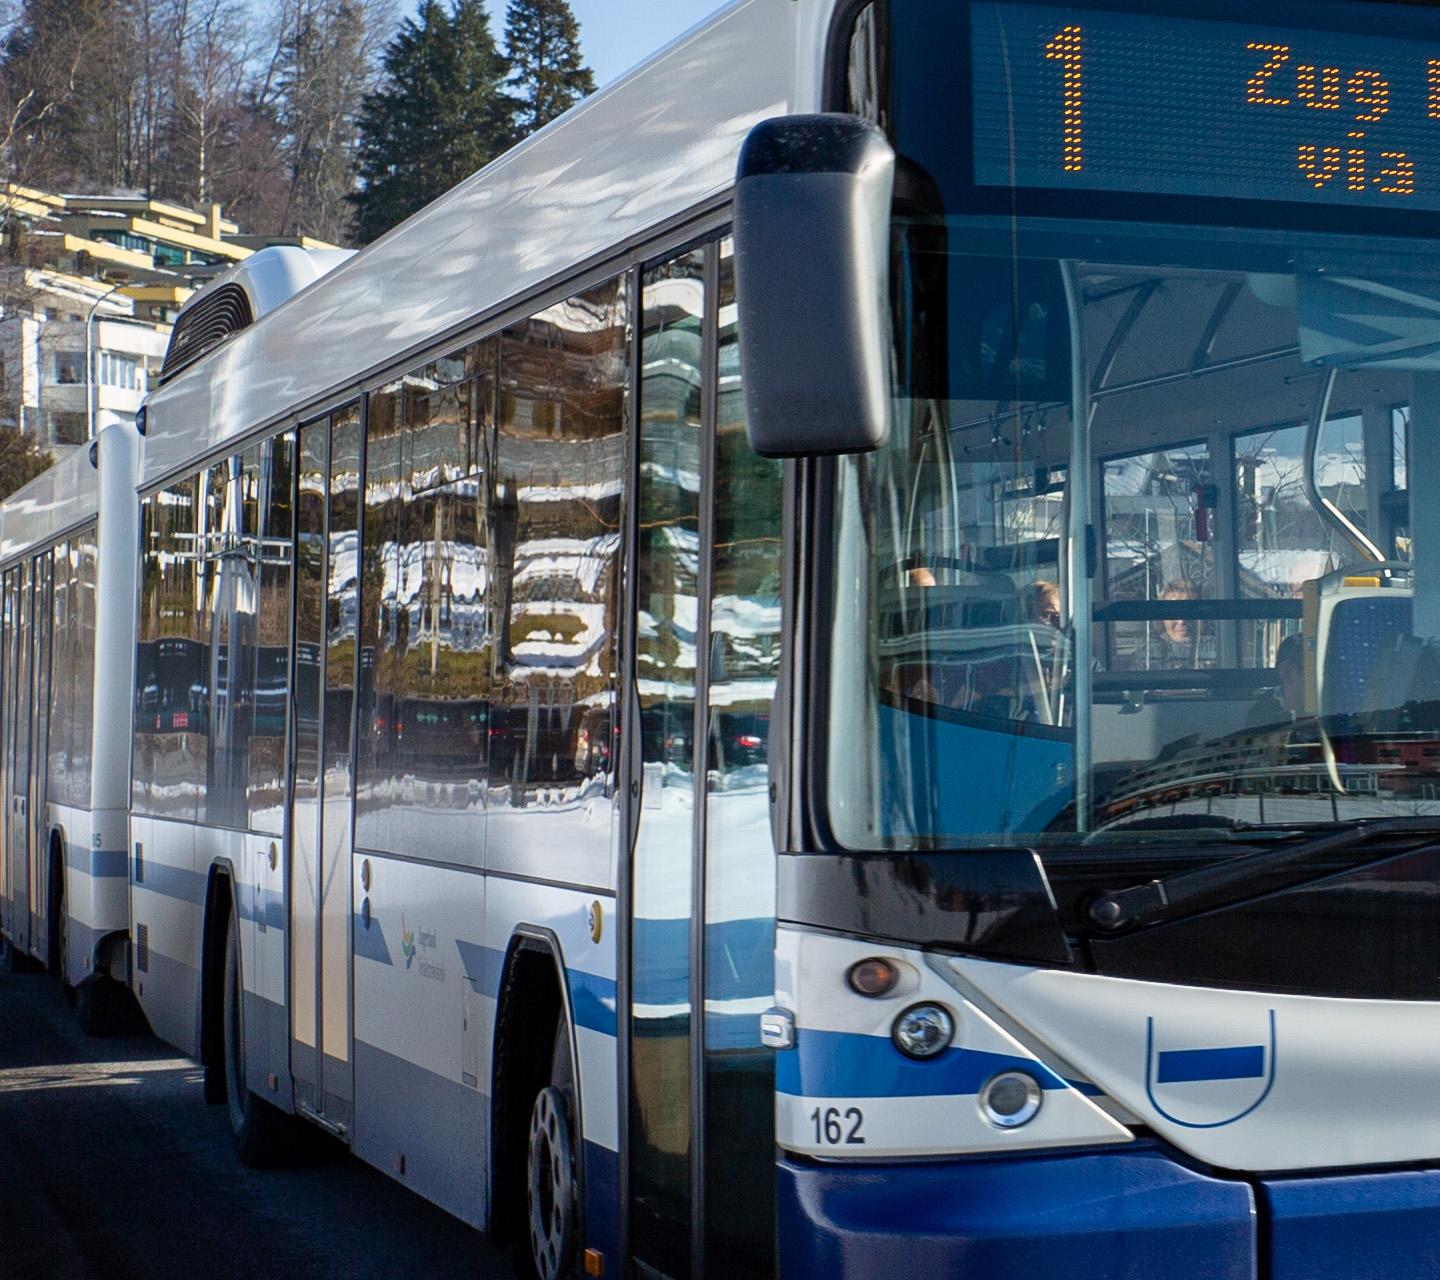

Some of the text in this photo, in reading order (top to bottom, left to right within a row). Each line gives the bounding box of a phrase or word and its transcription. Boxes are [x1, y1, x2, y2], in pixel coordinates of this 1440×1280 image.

[1045, 25, 1082, 172] 1
[1246, 43, 1389, 122] Zug
[1298, 130, 1415, 194] via
[811, 1106, 866, 1144] 162
